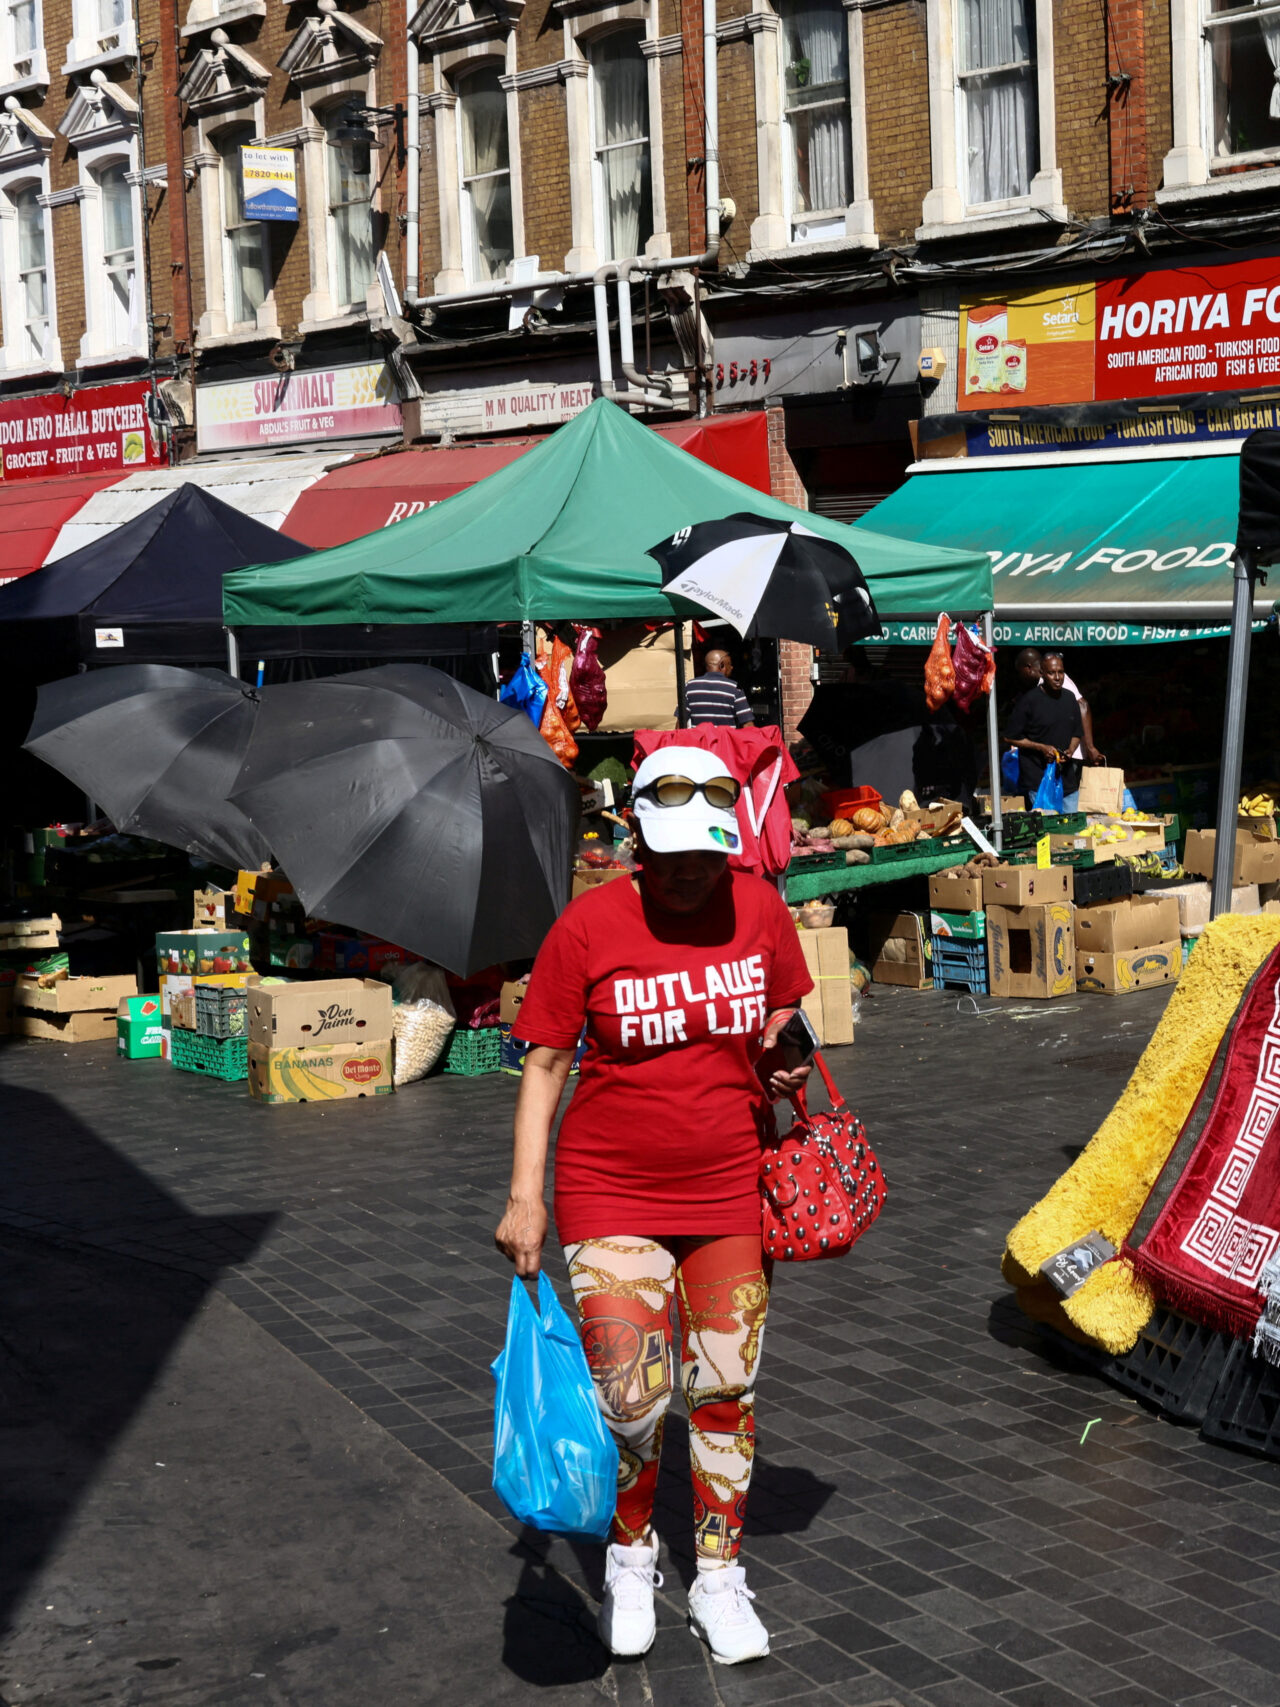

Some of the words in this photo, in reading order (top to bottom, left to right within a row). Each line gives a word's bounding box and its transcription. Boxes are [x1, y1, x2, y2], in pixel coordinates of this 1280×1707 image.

[270, 154, 289, 162] with
[1042, 311, 1079, 326] Setara
[1100, 292, 1230, 341] HORIYA
[1107, 351, 1135, 369] SOUTH
[1137, 346, 1182, 366] AMERICAN
[1183, 344, 1207, 361] FOOD
[1215, 339, 1254, 358] TURKISH
[1255, 337, 1280, 354] FOOD
[716, 358, 771, 381] 35-37
[1155, 364, 1193, 383] AFRICAN
[1194, 361, 1218, 379] FOOD
[1226, 360, 1247, 376] FISH
[1248, 358, 1255, 374] &
[254, 372, 335, 415] SUPERMALT
[485, 400, 494, 416] M
[497, 398, 506, 415] M
[510, 393, 556, 416] QUALITY
[26, 414, 53, 441] AFRO
[54, 410, 89, 438] HALAL
[92, 403, 144, 434] BUTCHER
[259, 421, 289, 436] ABDUL'S
[290, 418, 311, 432] FRUIT
[311, 418, 318, 428] &
[318, 416, 334, 428] VEG
[988, 425, 1021, 447] SOUTH
[1023, 424, 1076, 445] AMERICAN
[1078, 424, 1105, 441] FOOD
[1116, 415, 1164, 439] TURKISH
[1167, 411, 1196, 435] FOOD
[1207, 404, 1273, 433] CARIBBEAN
[6, 450, 48, 470] GROCERY
[56, 445, 85, 464] FRUIT
[86, 445, 94, 461] &
[96, 441, 117, 459] VEG
[1074, 542, 1236, 573] FOOD
[681, 580, 743, 620] TaylorMade
[1024, 626, 1083, 642] AFRICAN
[1087, 626, 1128, 641] FOOD
[1142, 625, 1176, 640] FISH
[614, 954, 765, 1014] OUTLAWS
[326, 1003, 353, 1020] Don
[621, 1008, 688, 1048] FOR
[705, 994, 766, 1035] LIFE
[312, 1016, 356, 1037] Jaime
[274, 1057, 334, 1071] BANANAS
[345, 1066, 357, 1074] Del
[357, 1064, 380, 1073] Monte
